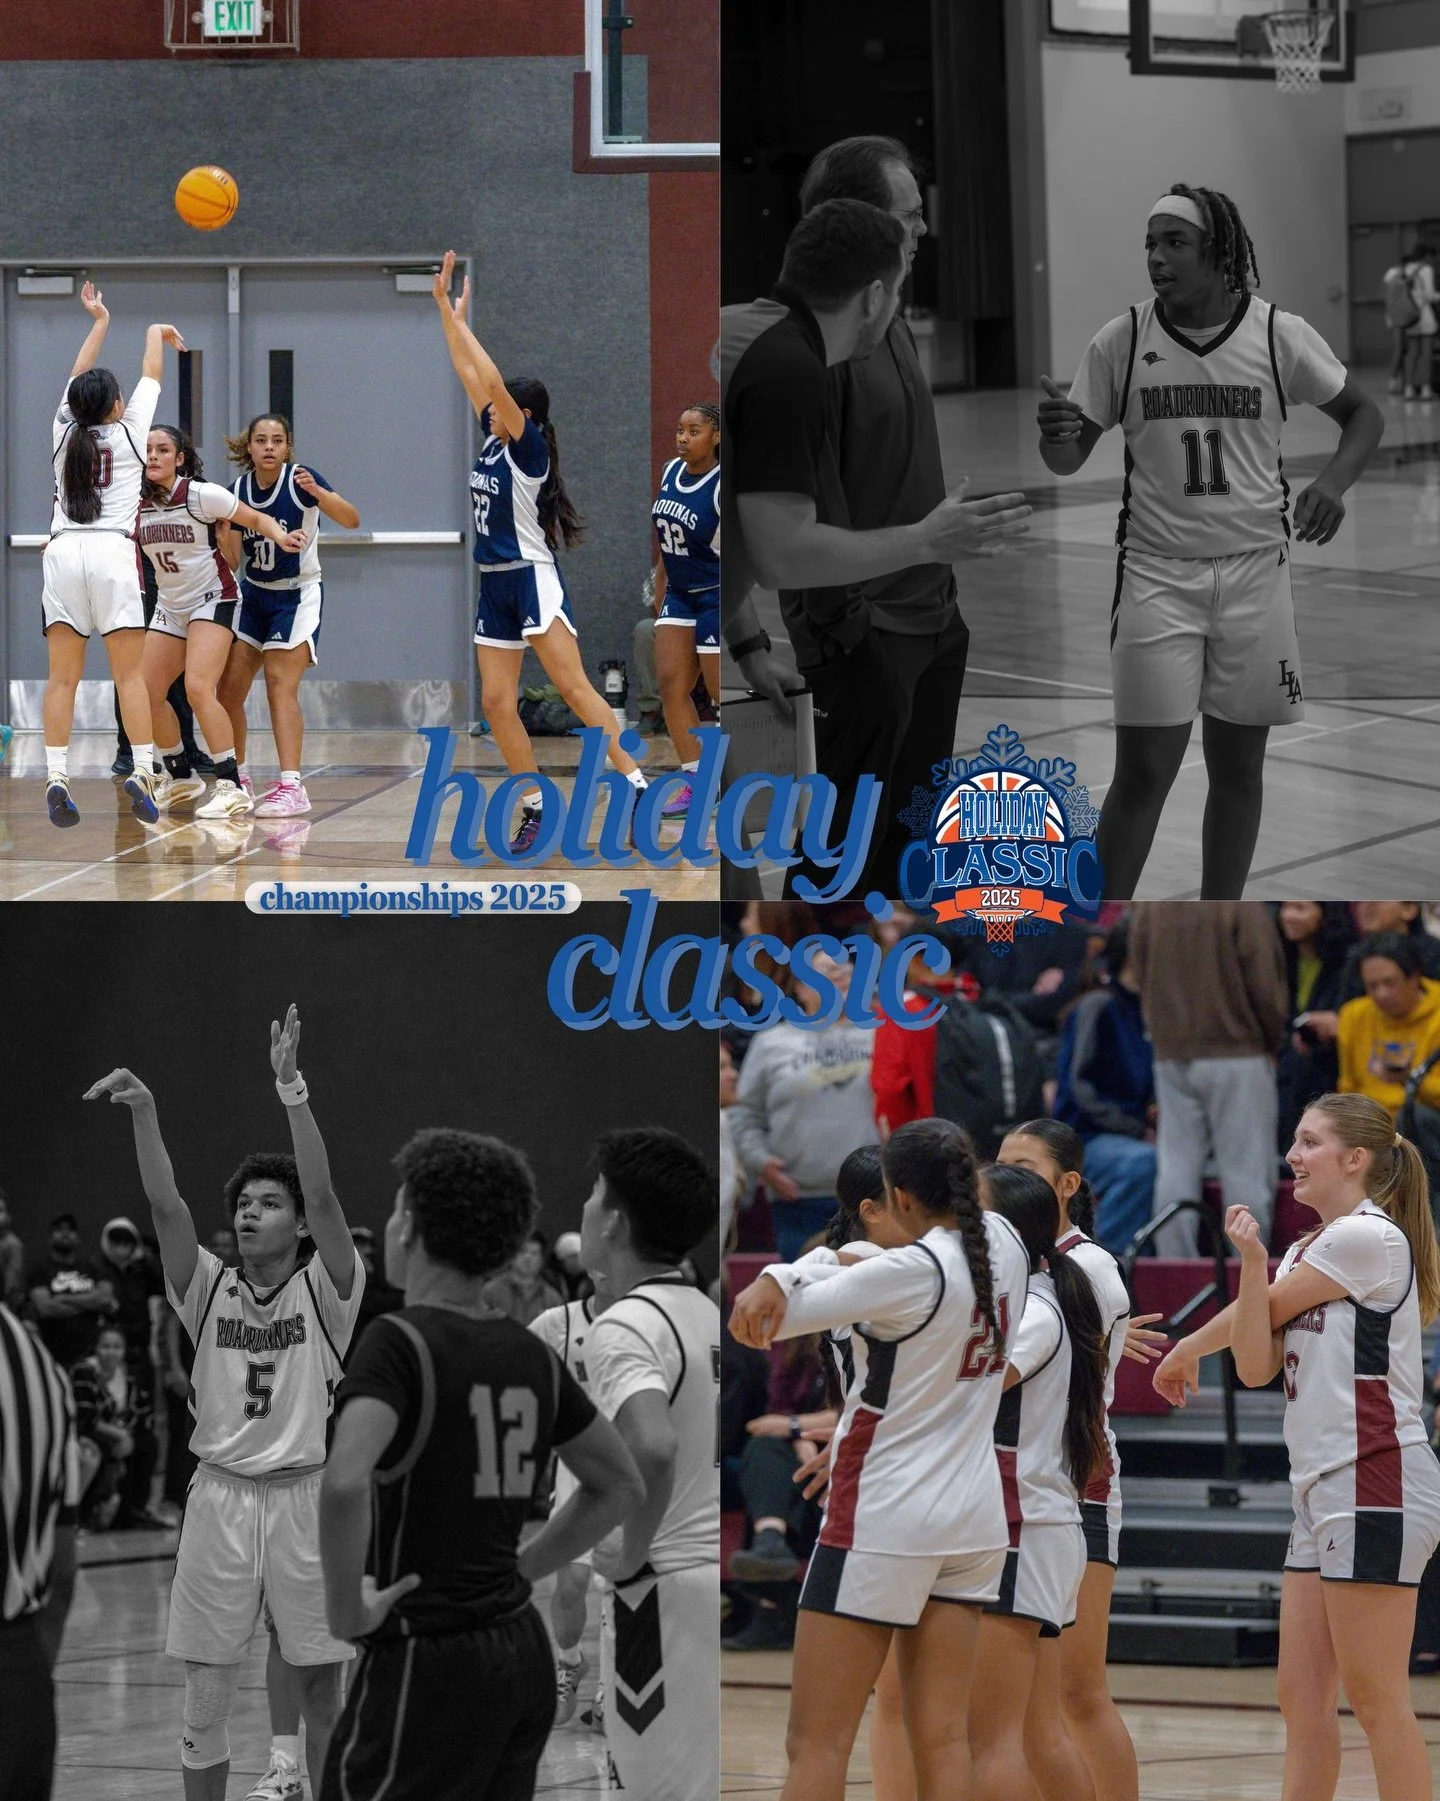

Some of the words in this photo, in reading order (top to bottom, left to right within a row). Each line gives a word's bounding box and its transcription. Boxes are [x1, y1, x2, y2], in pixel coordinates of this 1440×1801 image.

[215, 1, 254, 30] EXIT
[1140, 384, 1262, 420] ROADRUNNERS
[1181, 430, 1230, 496] 11
[472, 491, 490, 537] 22
[651, 499, 698, 531] AQUINAS
[139, 523, 195, 545] ADRUNNERS
[656, 518, 689, 557] 32
[155, 551, 180, 573] 15
[251, 539, 275, 571] 10
[216, 1312, 307, 1354] ROADRUNNERS
[956, 1292, 1010, 1381] 21
[244, 1361, 276, 1421] 5
[469, 1383, 539, 1499] 12
